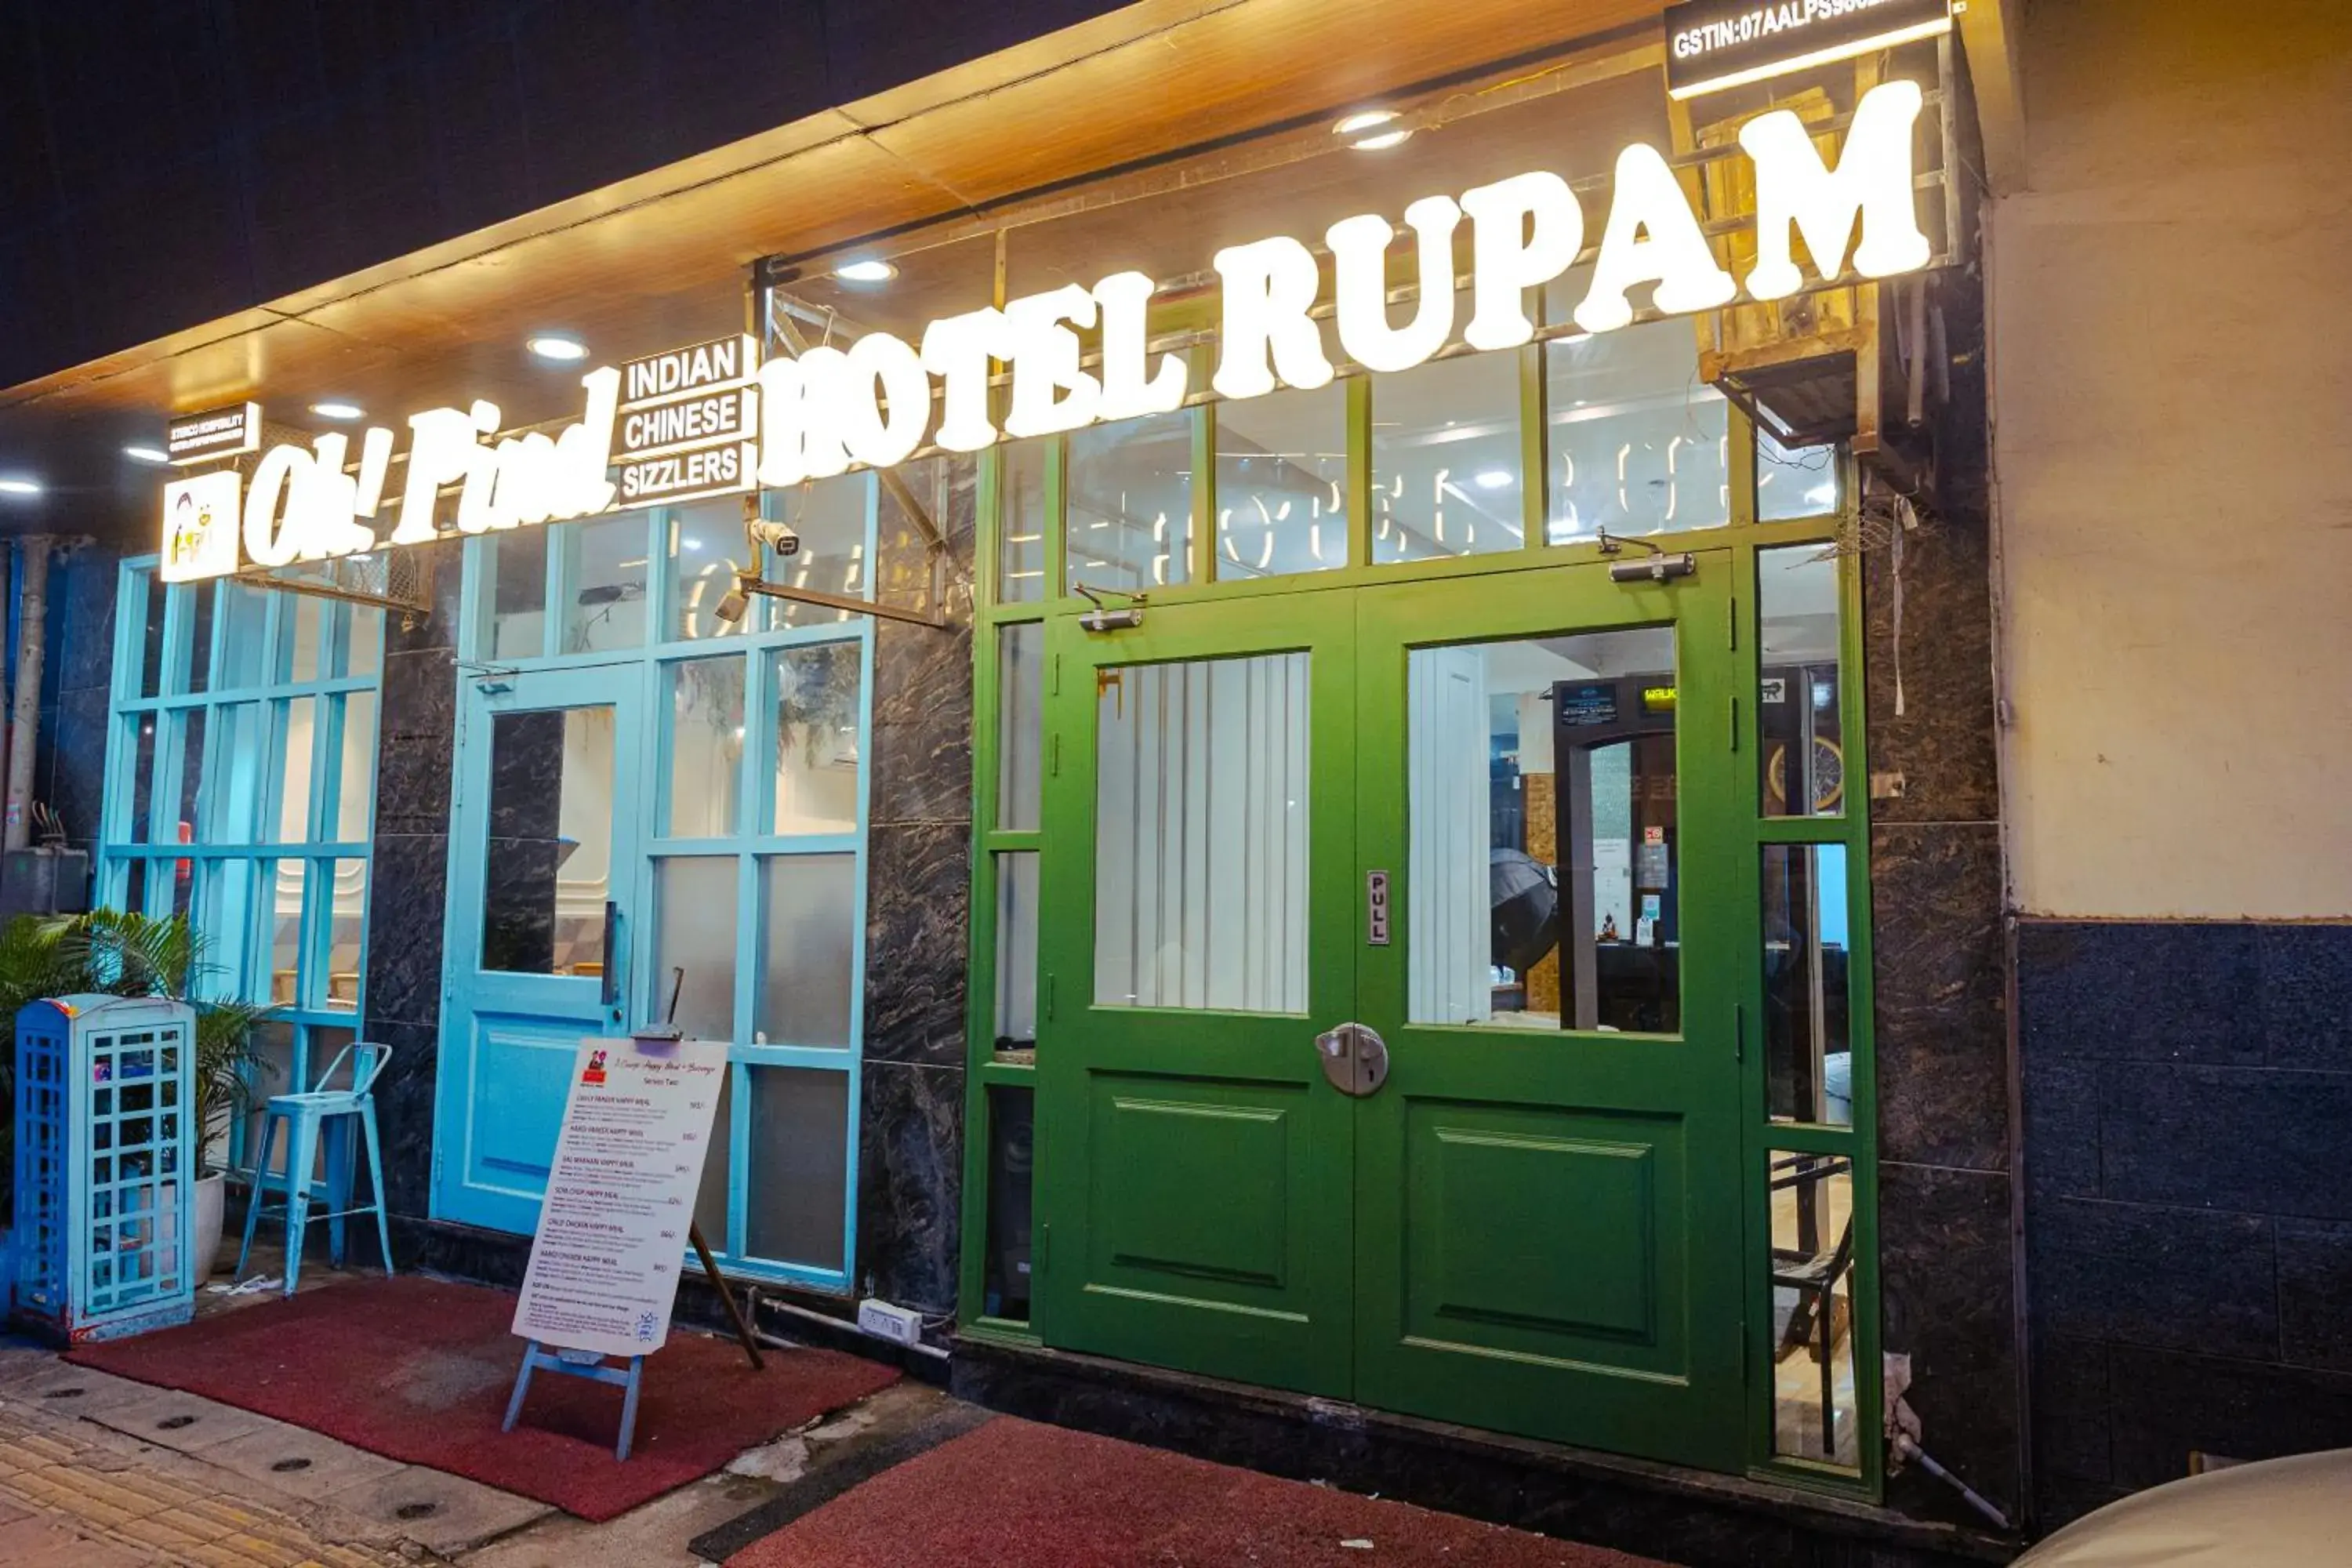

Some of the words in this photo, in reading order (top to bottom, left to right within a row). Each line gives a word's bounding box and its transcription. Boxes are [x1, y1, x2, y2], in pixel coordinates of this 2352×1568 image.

[1673, 0, 1882, 58] GSTIN:07AALPS9
[757, 271, 1189, 487] HOTEL
[1212, 78, 1932, 400] RUPAM
[628, 339, 735, 400] INDIAN
[625, 394, 737, 448] CHINESE
[243, 426, 394, 567] Oh!
[622, 447, 739, 497] SIZZLERS
[1372, 877, 1385, 938] PULL
